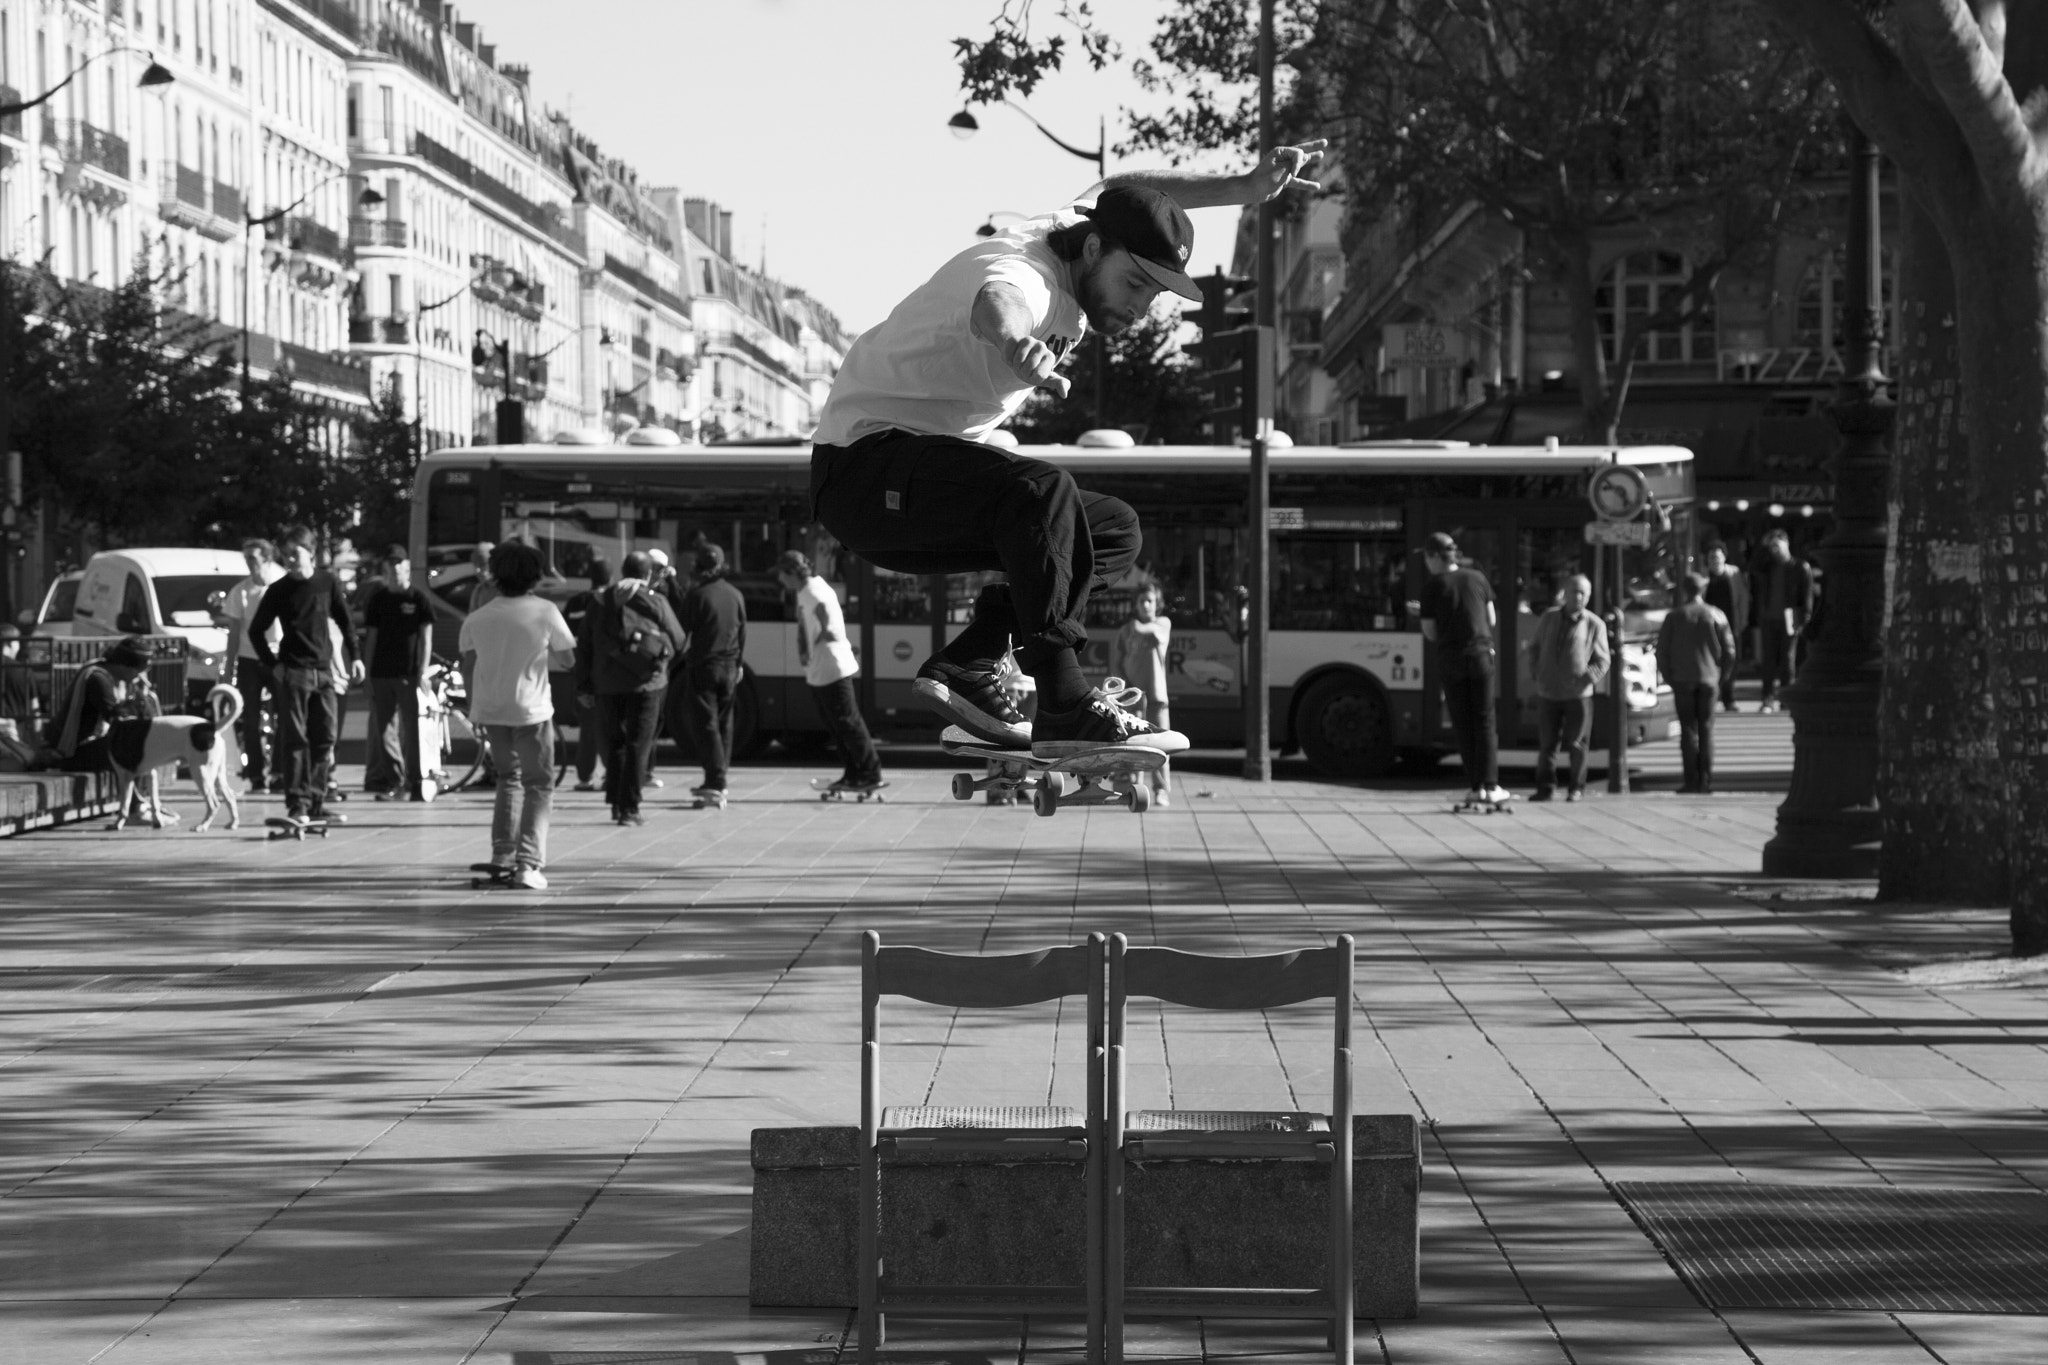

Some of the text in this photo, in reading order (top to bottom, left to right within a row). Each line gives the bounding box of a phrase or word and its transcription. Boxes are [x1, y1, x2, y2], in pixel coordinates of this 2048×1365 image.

[1404, 339, 1445, 355] PINO
[1717, 347, 1846, 382] PIZZA
[1769, 484, 1825, 501] PIZZA
